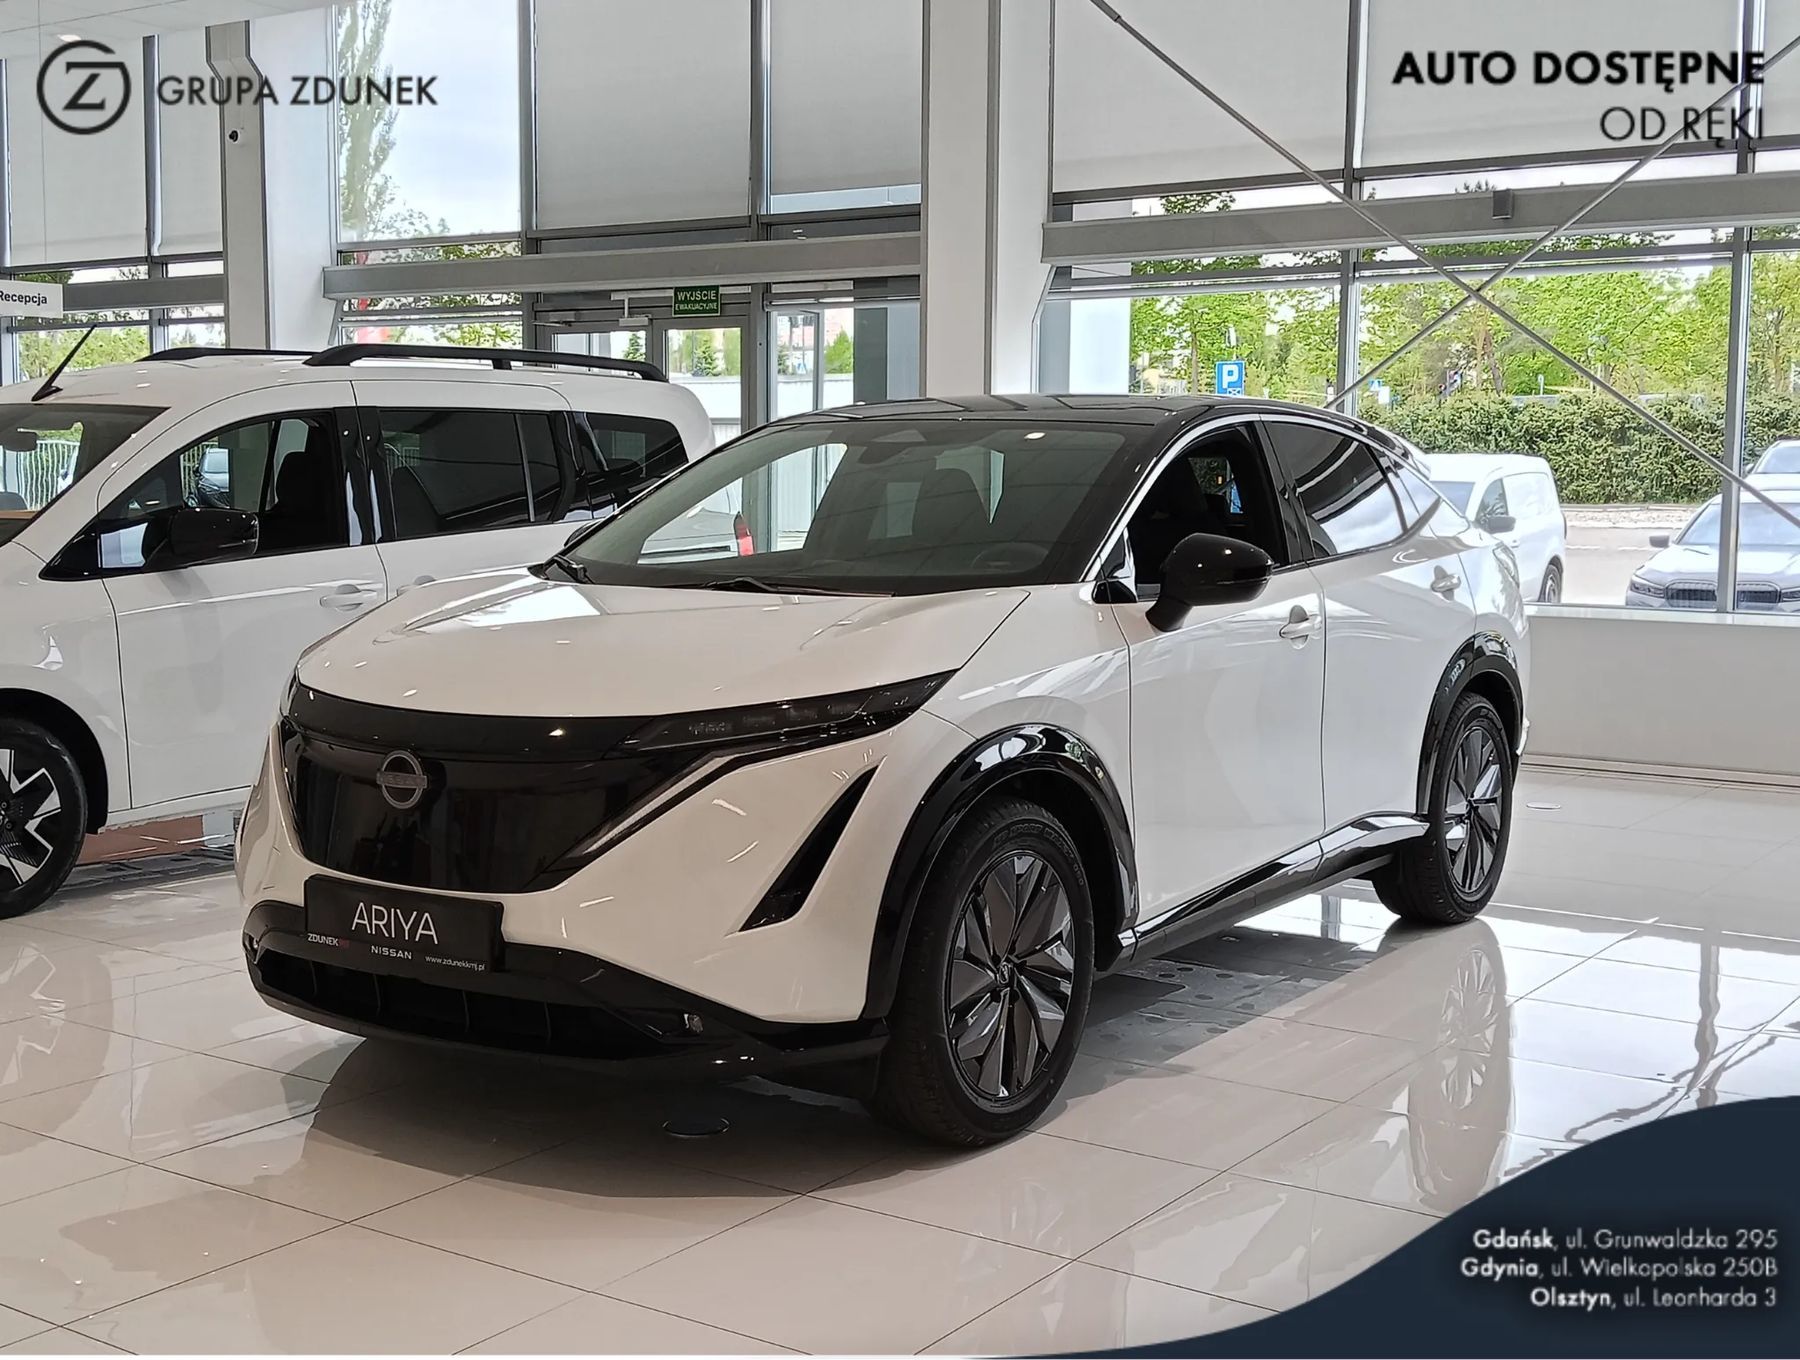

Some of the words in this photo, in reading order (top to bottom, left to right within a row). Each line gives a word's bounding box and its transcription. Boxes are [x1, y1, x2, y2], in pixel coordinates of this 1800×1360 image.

[0, 290, 48, 307] Recepcja
[1222, 364, 1239, 389] P
[351, 901, 439, 946] ARIYA
[307, 932, 340, 948] ZDUNEK
[371, 945, 412, 960] NISSAN
